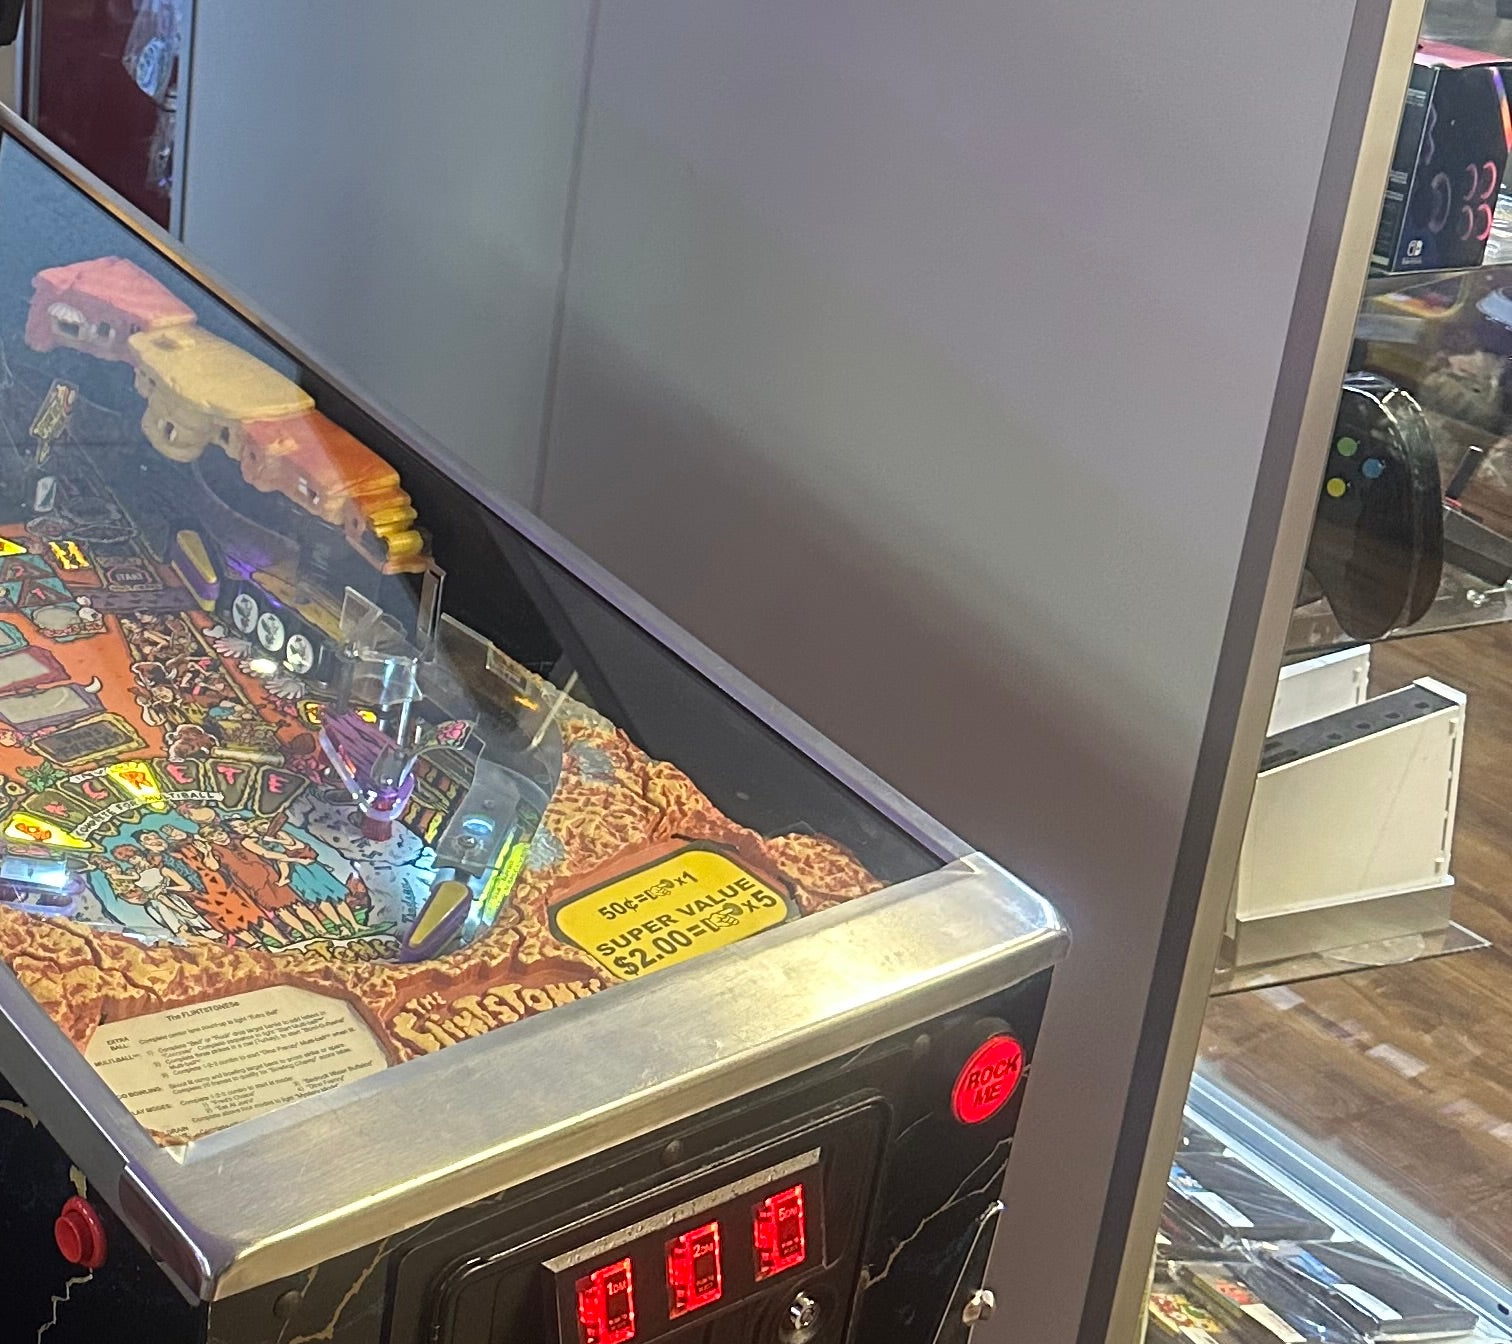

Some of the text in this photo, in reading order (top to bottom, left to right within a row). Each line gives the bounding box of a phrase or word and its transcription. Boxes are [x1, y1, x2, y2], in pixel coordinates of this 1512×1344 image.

[595, 877, 756, 957] SUPER VALUE
[406, 992, 447, 1015] THE
[166, 1013, 181, 1021] The
[105, 1036, 129, 1045] EXTRA
[966, 1053, 1021, 1092] ROCK
[973, 1082, 1001, 1108] ME
